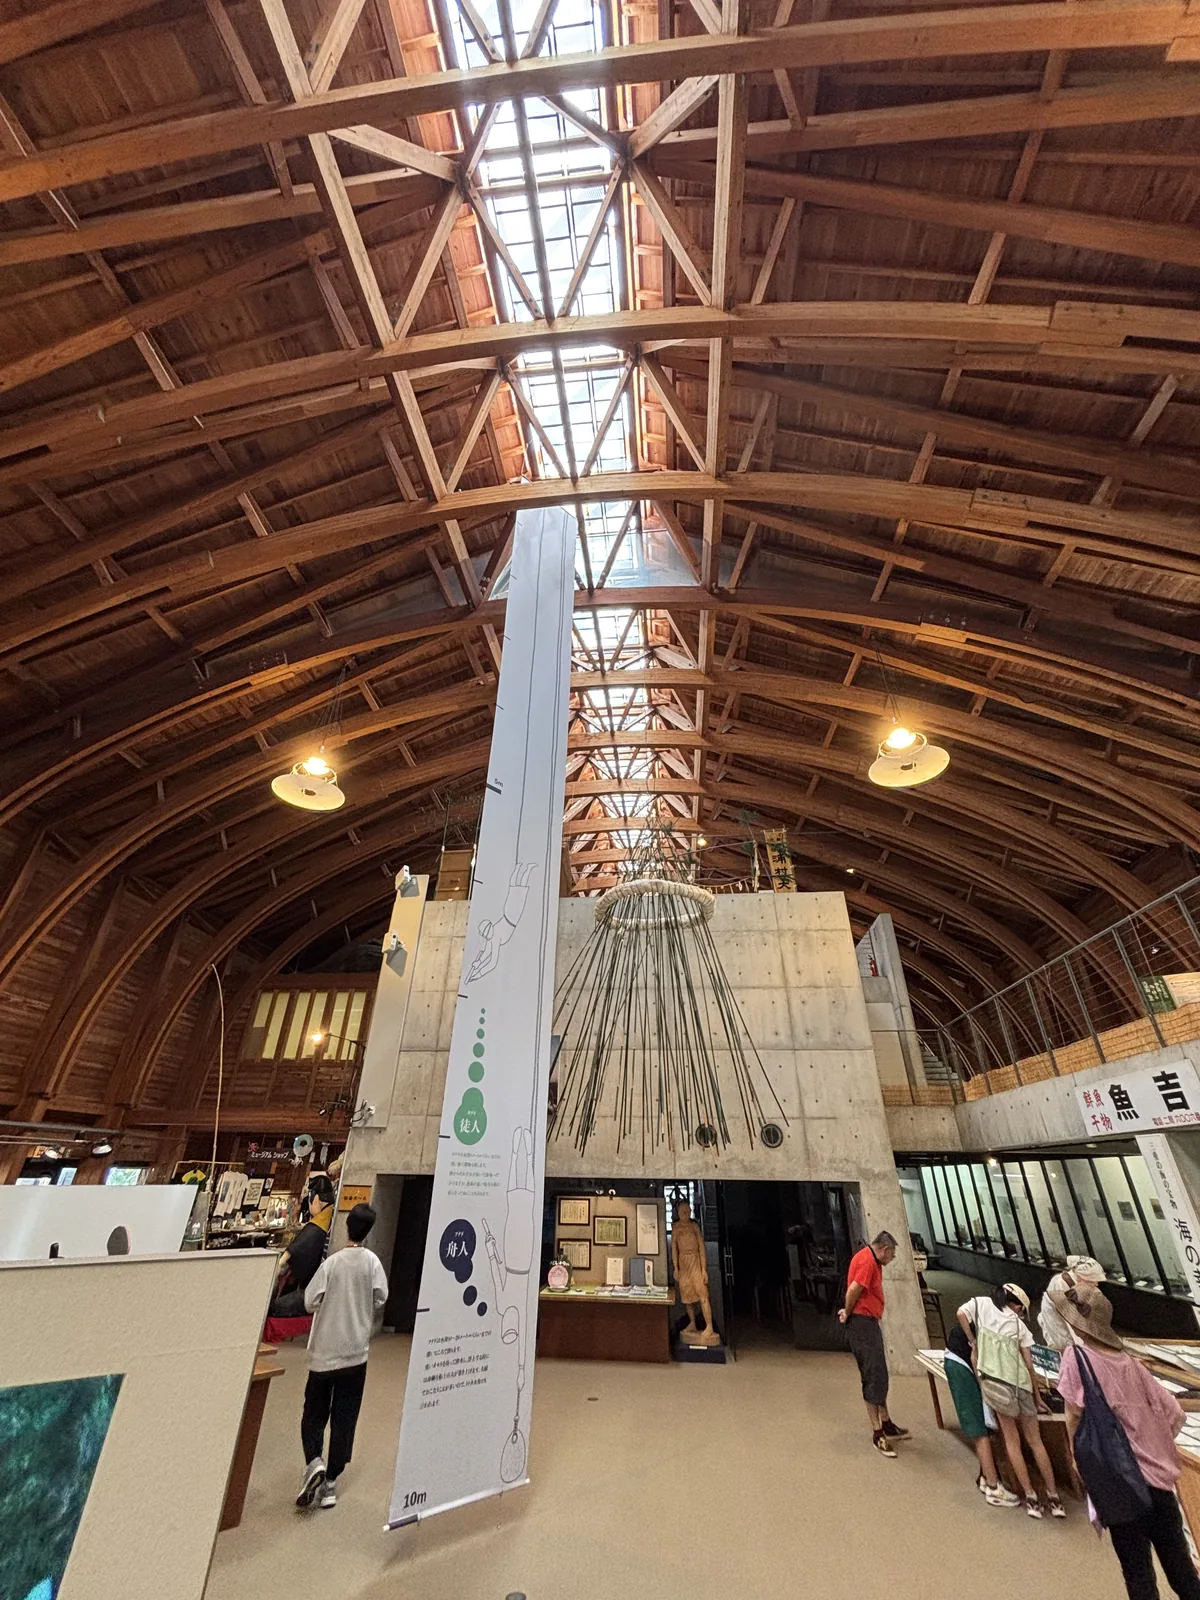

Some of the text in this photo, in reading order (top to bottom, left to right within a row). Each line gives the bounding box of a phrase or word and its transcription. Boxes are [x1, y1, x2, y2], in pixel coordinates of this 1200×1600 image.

[494, 778, 503, 787] 5m
[1082, 1088, 1104, 1108] 鮮魚
[1108, 1070, 1190, 1121] 魚吉
[460, 1118, 480, 1133] 徒人
[1091, 1112, 1113, 1132] 干物
[445, 1241, 469, 1258] 舟人
[403, 1491, 427, 1509] 10m
